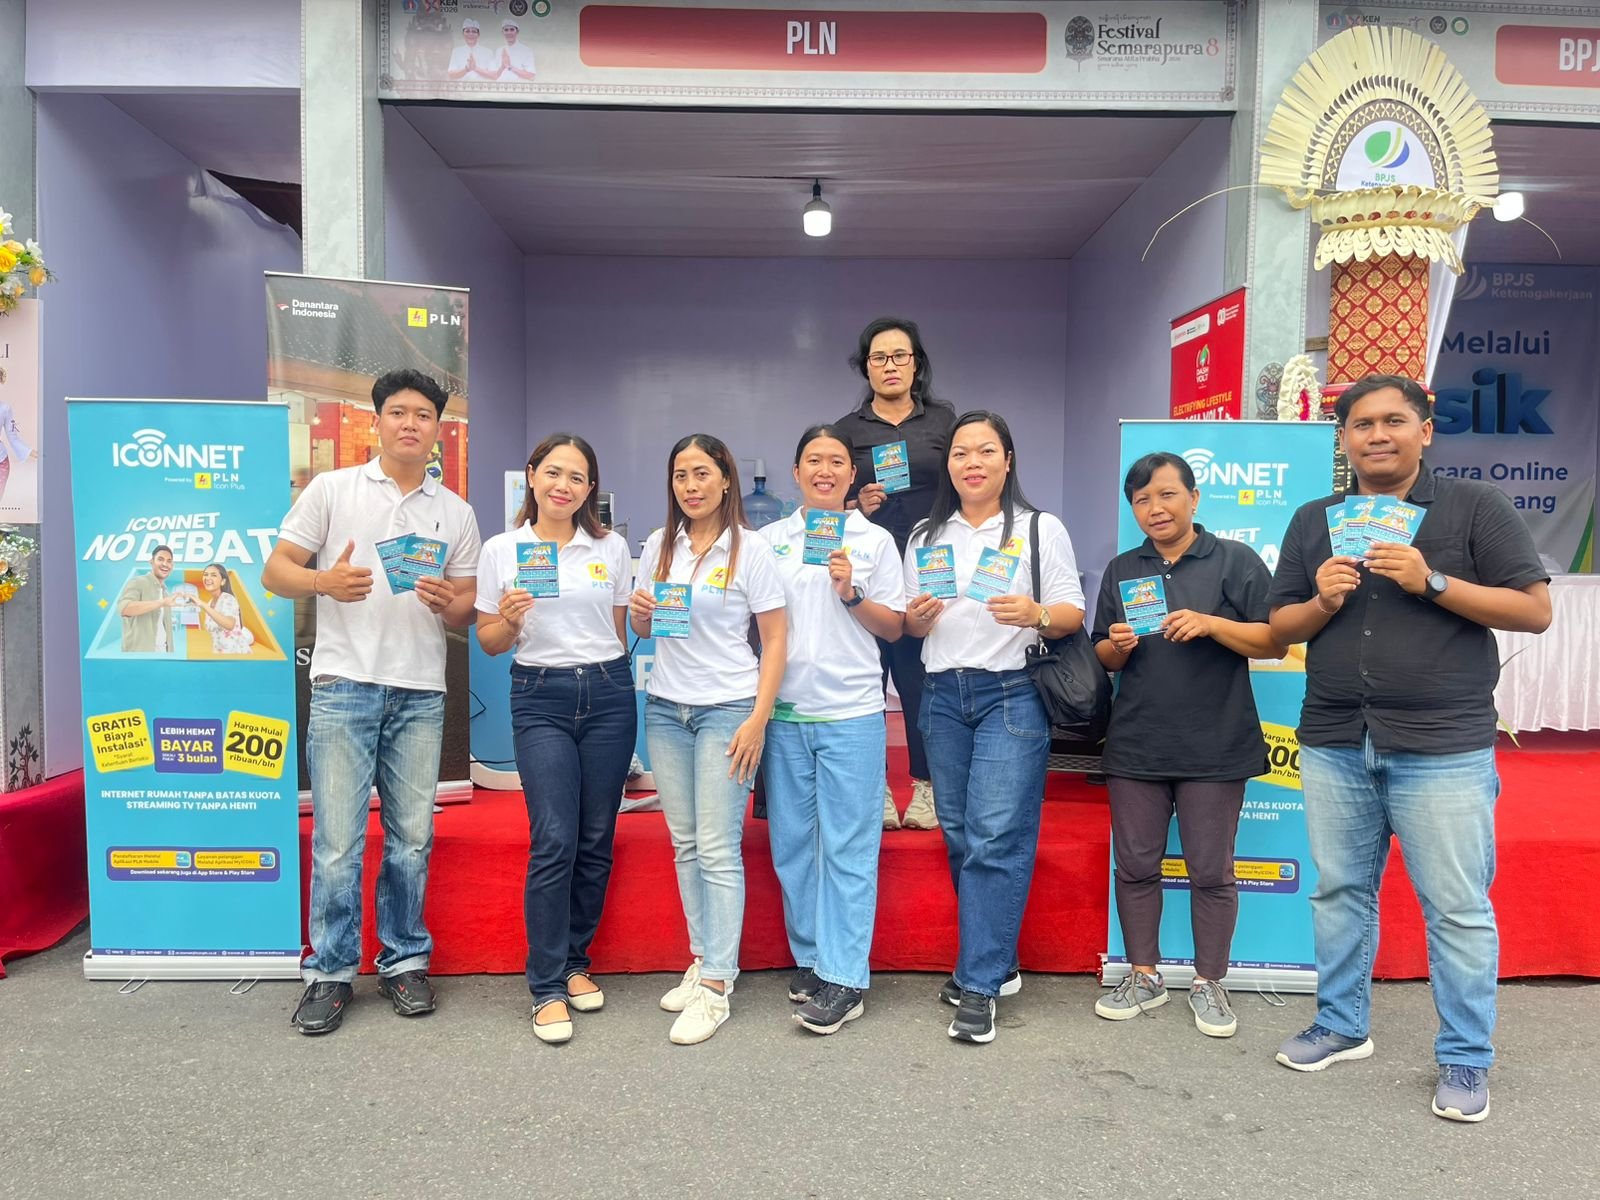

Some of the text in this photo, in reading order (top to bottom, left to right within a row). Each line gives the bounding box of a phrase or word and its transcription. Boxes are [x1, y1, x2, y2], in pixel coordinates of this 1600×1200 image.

[1098, 17, 1162, 39] Festival
[786, 21, 836, 55] PLN
[1096, 38, 1219, 65] Semarapura 8
[1375, 173, 1396, 182] BPJS
[1492, 272, 1534, 288] BPJS
[1491, 288, 1593, 300] Ketenagakerjaan
[292, 299, 339, 310] Danantara
[292, 308, 337, 319] Indonesia
[429, 313, 461, 326] PLN
[1440, 331, 1550, 355] Melalui
[1433, 367, 1555, 435] sik
[112, 441, 245, 469] ICONNET
[213, 472, 239, 482] PLN
[1490, 462, 1569, 481] Online
[1256, 489, 1282, 499] PLN
[125, 512, 221, 532] ICONNET
[82, 533, 136, 561] NO
[92, 716, 142, 733] GRATIS
[160, 727, 216, 736] LEBIH HEMAT
[234, 721, 283, 737] Harga Mulai
[104, 731, 134, 742] Biaya
[161, 739, 214, 753] BAYAR
[226, 731, 283, 761] 200
[177, 753, 217, 763] 3 bulan
[229, 753, 276, 769] ribuan/bln
[101, 790, 281, 800] INTERNET RUMAH TANPA BATAS KUOTA
[126, 801, 257, 810] STREAMING TV TANPA HENTI
[1272, 801, 1304, 811] KUOTA
[1252, 811, 1280, 821] HENTI
